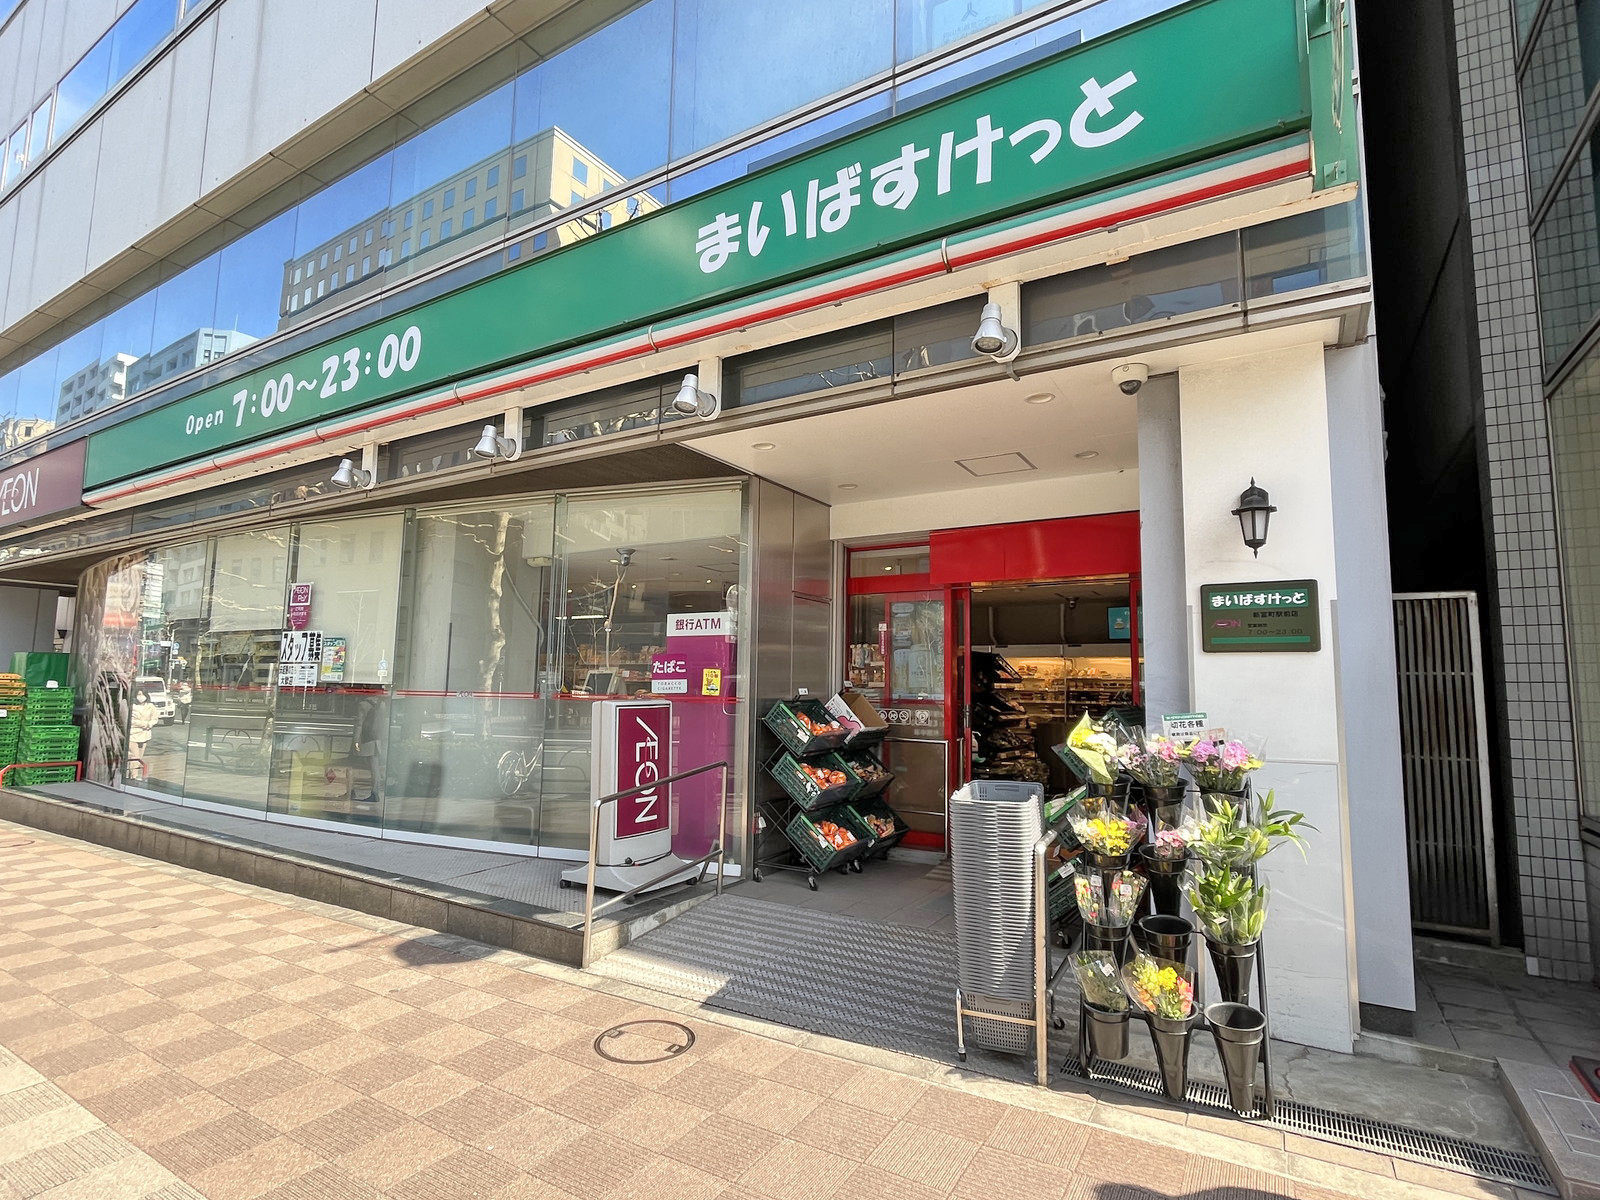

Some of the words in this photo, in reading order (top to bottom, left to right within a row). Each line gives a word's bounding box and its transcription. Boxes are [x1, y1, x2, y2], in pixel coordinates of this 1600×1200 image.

[695, 71, 1145, 274] まいばすけっと
[186, 409, 224, 435] Open
[1211, 592, 1306, 607] まいばすけっと
[675, 617, 721, 631] 銀行ATM
[652, 660, 686, 674] たばこ
